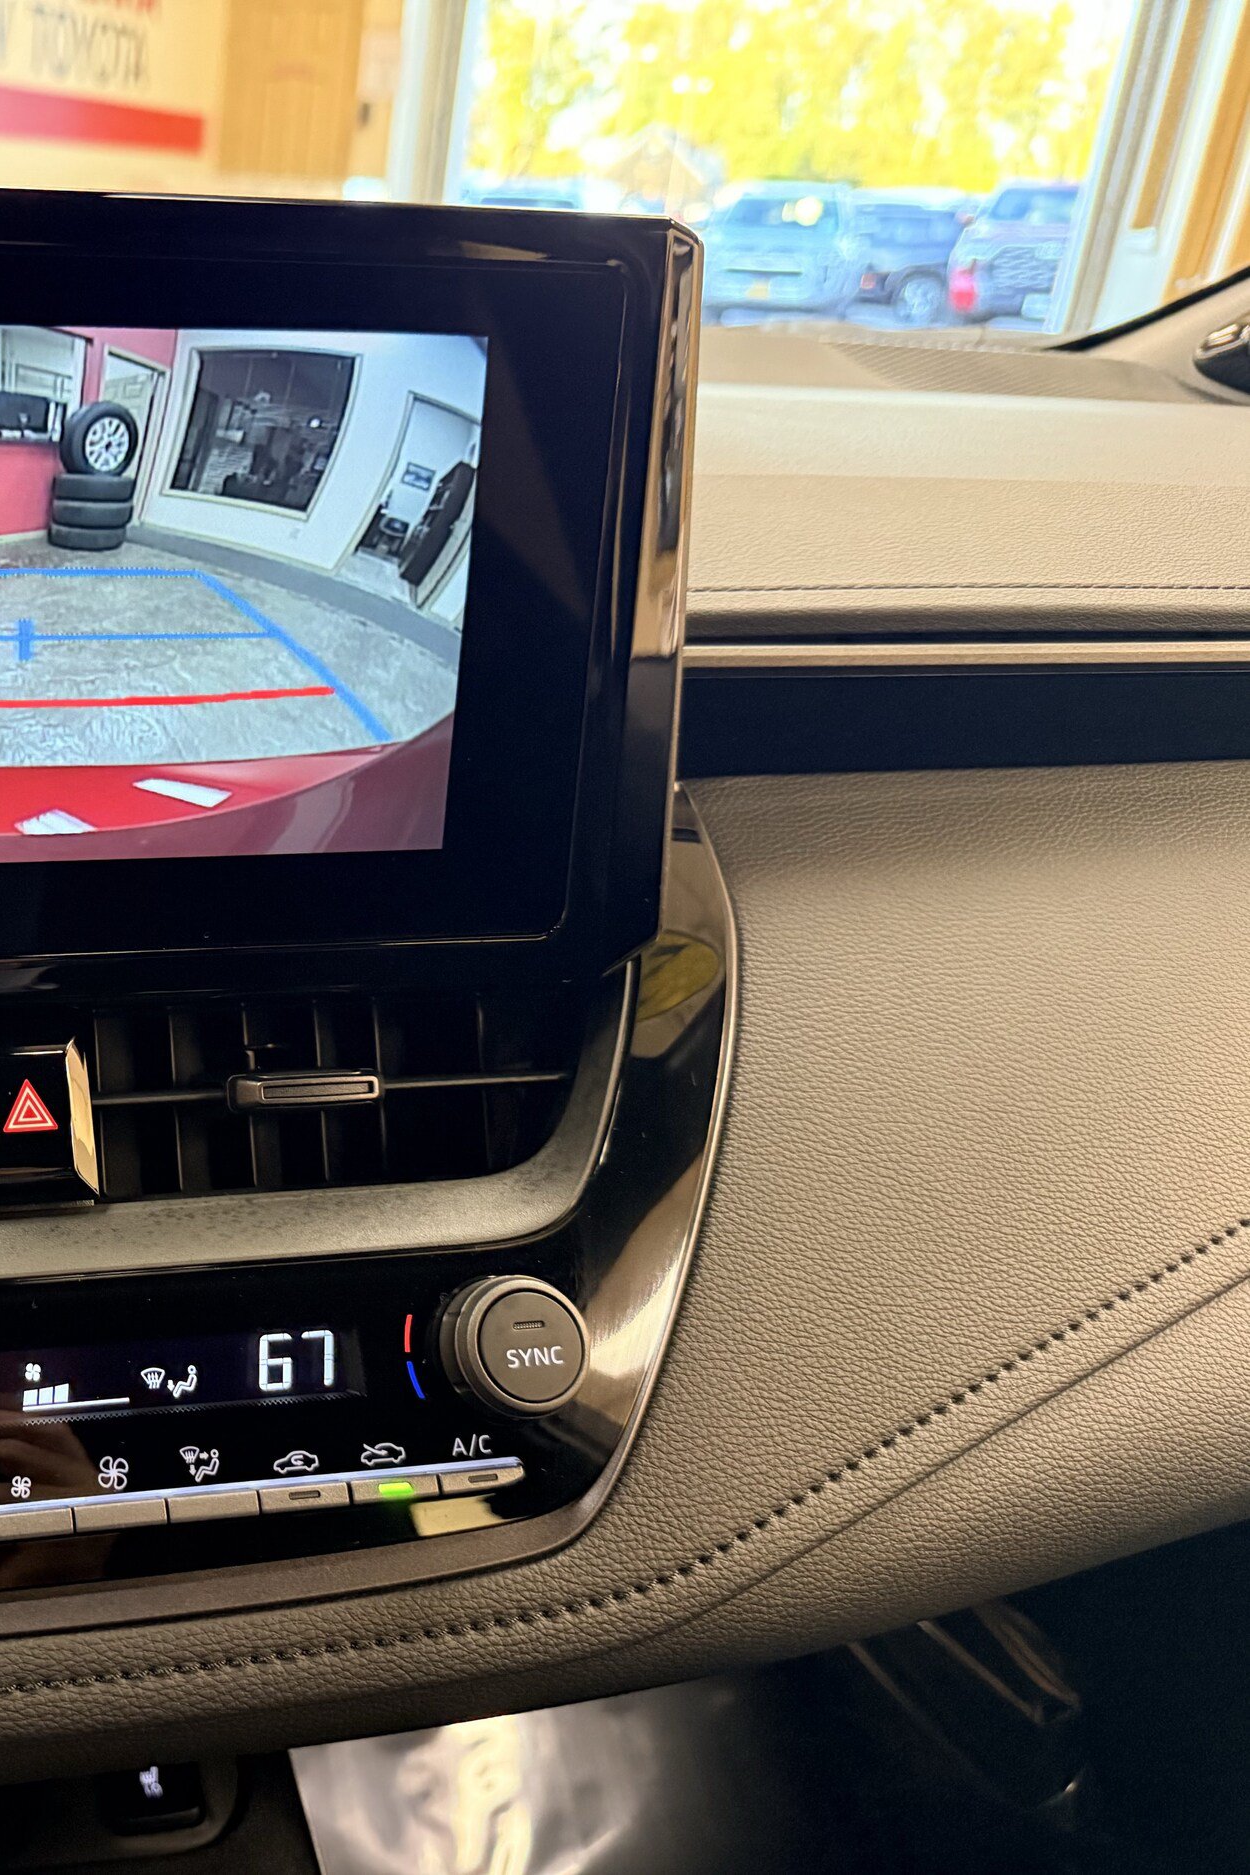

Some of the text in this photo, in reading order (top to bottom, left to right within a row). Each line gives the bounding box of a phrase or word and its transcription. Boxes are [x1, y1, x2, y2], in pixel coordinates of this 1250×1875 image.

[258, 1330, 335, 1391] 67
[506, 1345, 564, 1368] SYNC
[452, 1434, 492, 1457] A/C
